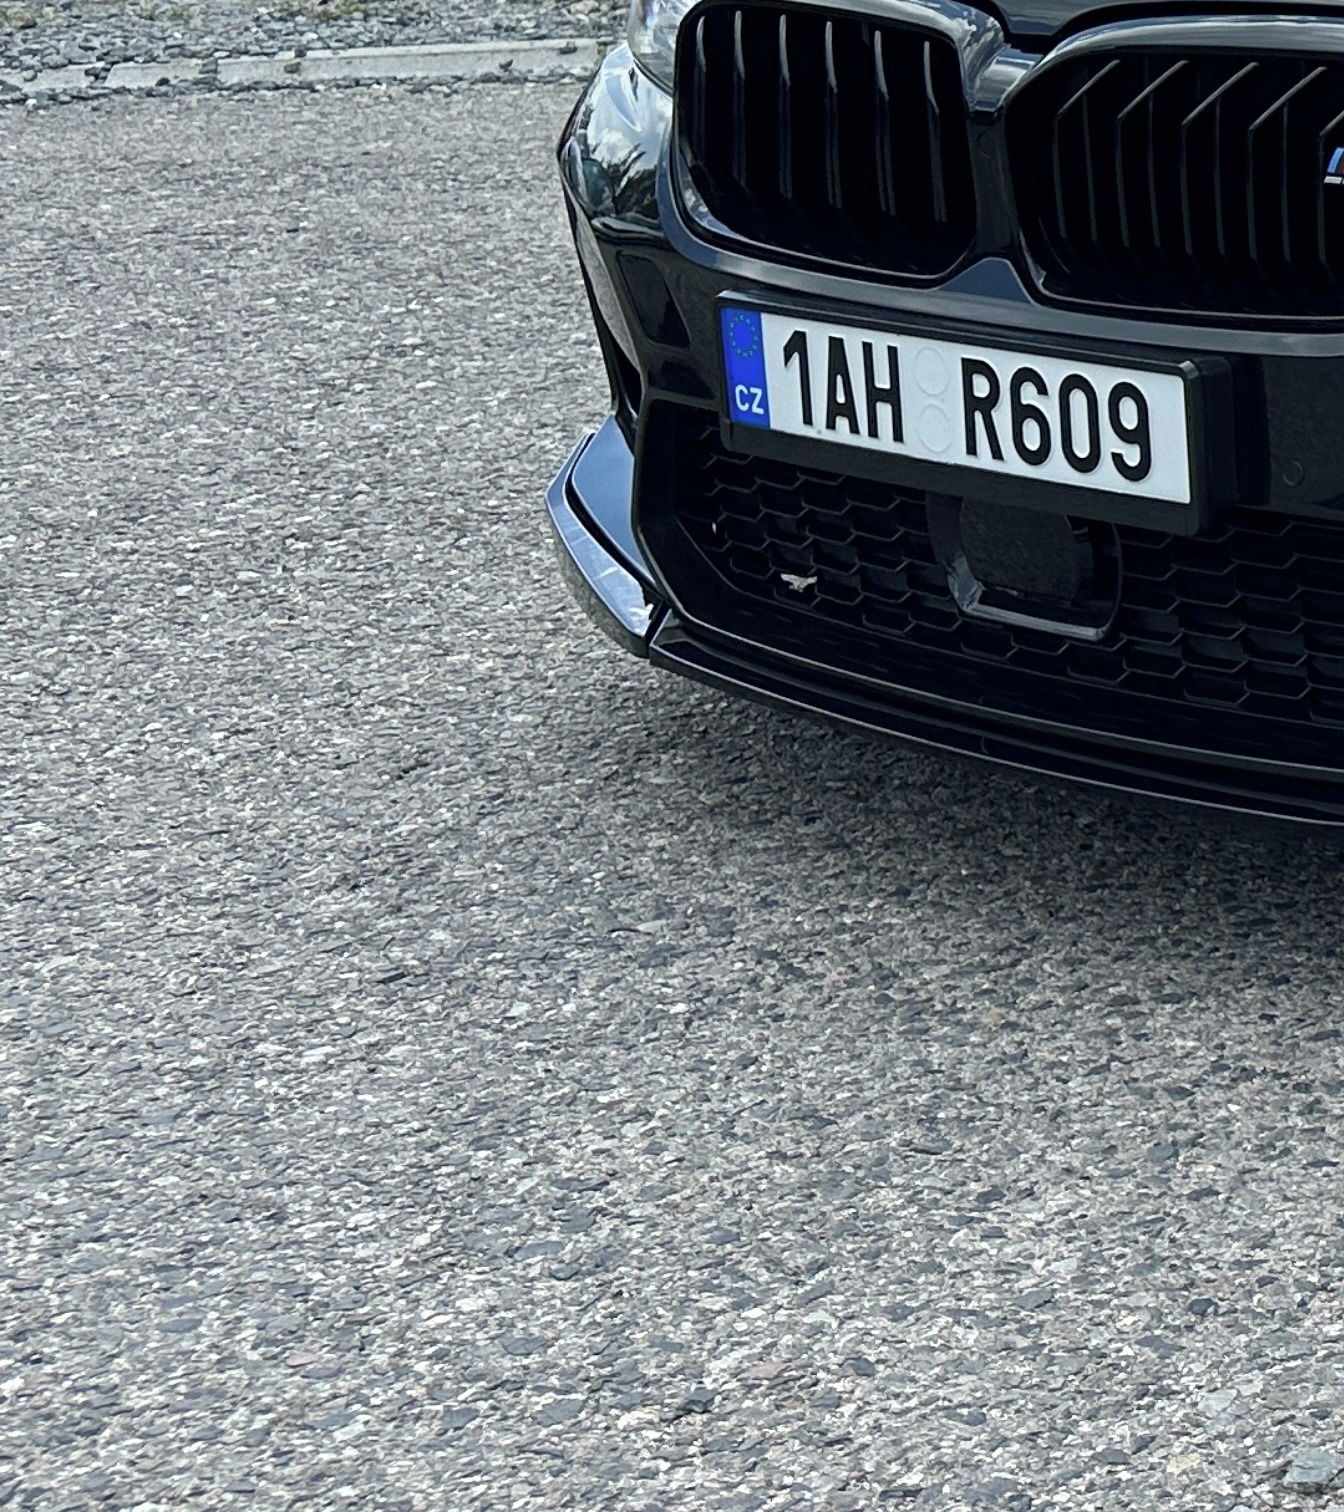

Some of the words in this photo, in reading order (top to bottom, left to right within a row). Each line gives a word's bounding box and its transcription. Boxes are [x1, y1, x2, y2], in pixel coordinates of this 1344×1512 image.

[734, 384, 764, 415] CZ
[782, 329, 904, 444] 1AH
[960, 355, 1152, 482] R609
